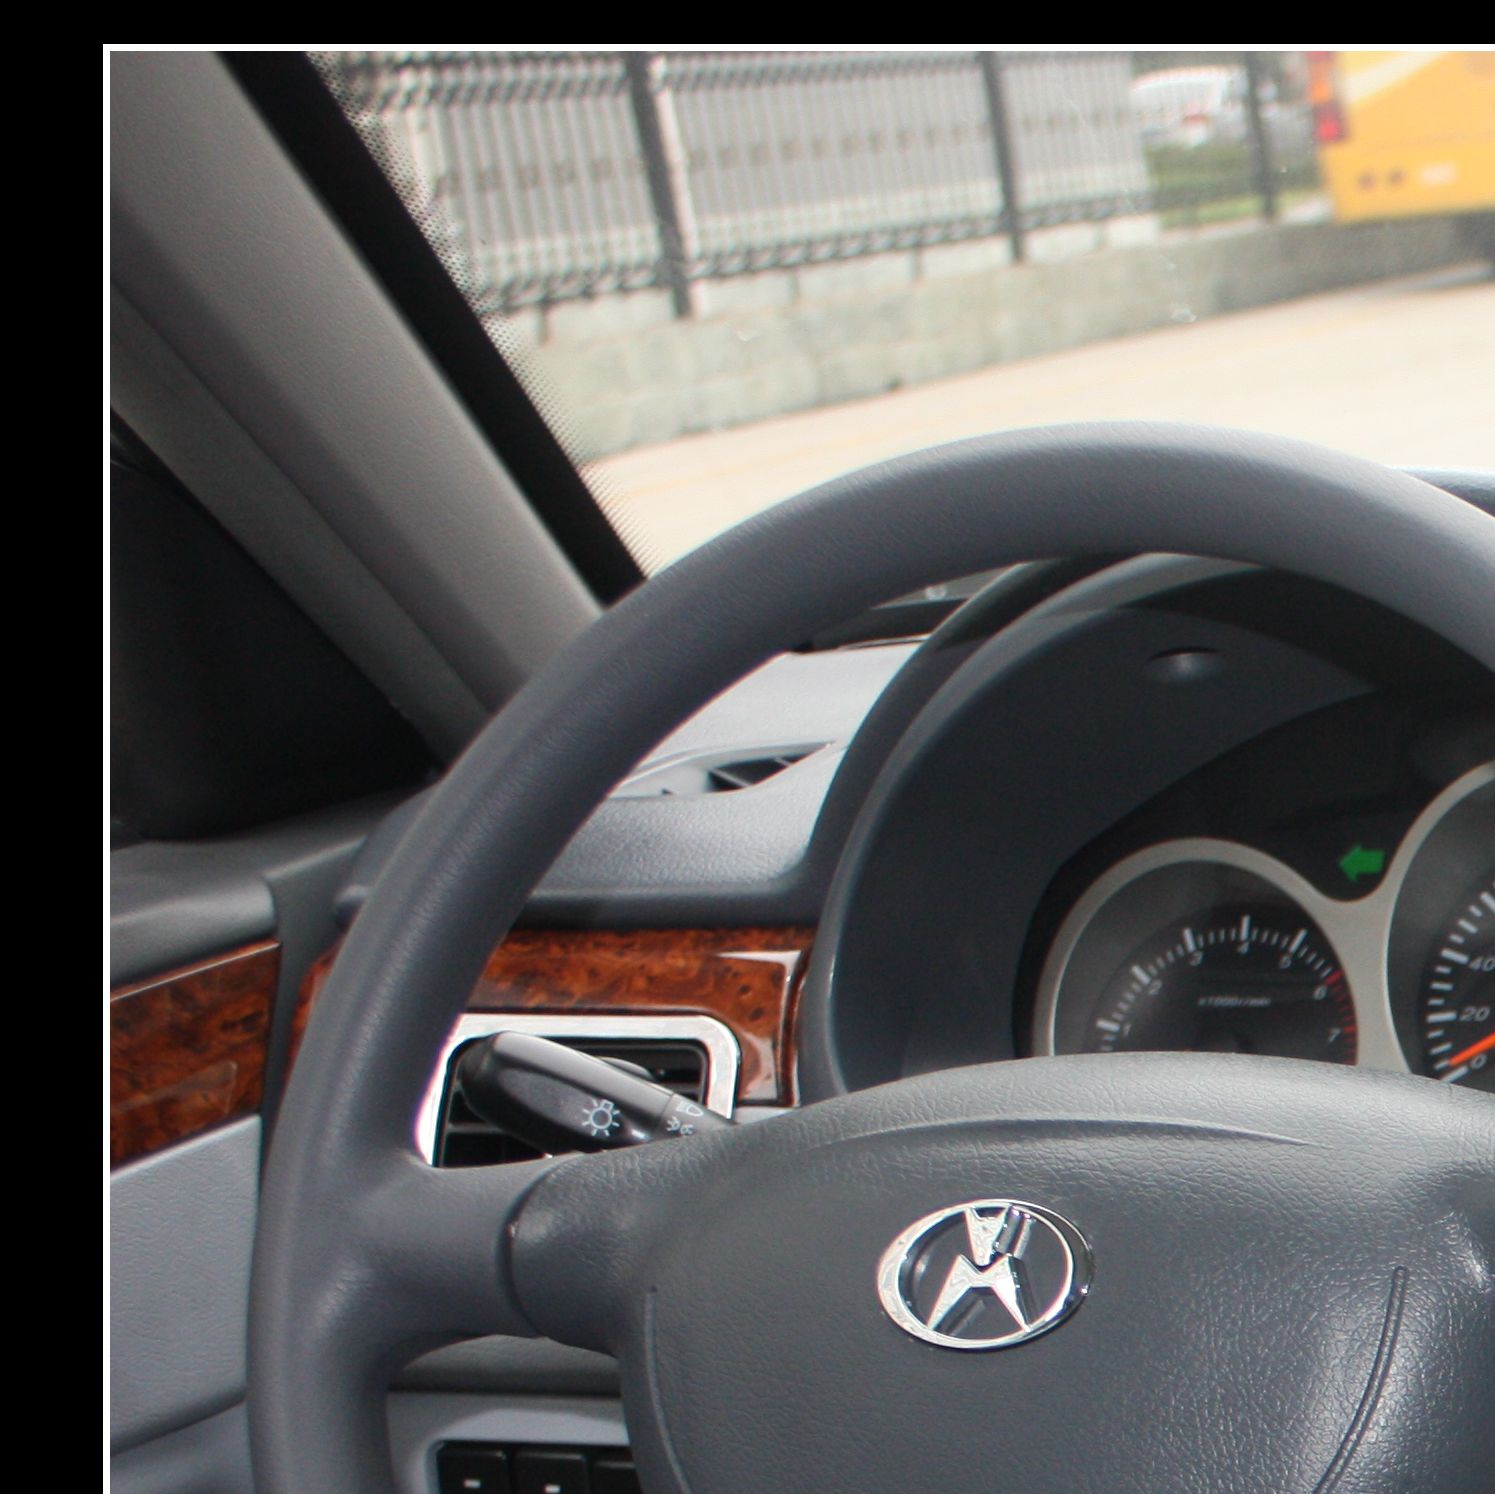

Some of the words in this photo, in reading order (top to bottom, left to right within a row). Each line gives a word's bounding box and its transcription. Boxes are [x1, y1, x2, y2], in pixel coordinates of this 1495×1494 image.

[1189, 952, 1204, 967] 3
[1148, 980, 1164, 995] 2
[1460, 1006, 1491, 1021] 20
[1123, 1023, 1132, 1037] 1
[1327, 1028, 1341, 1042] 7
[1470, 1054, 1488, 1069] 0
